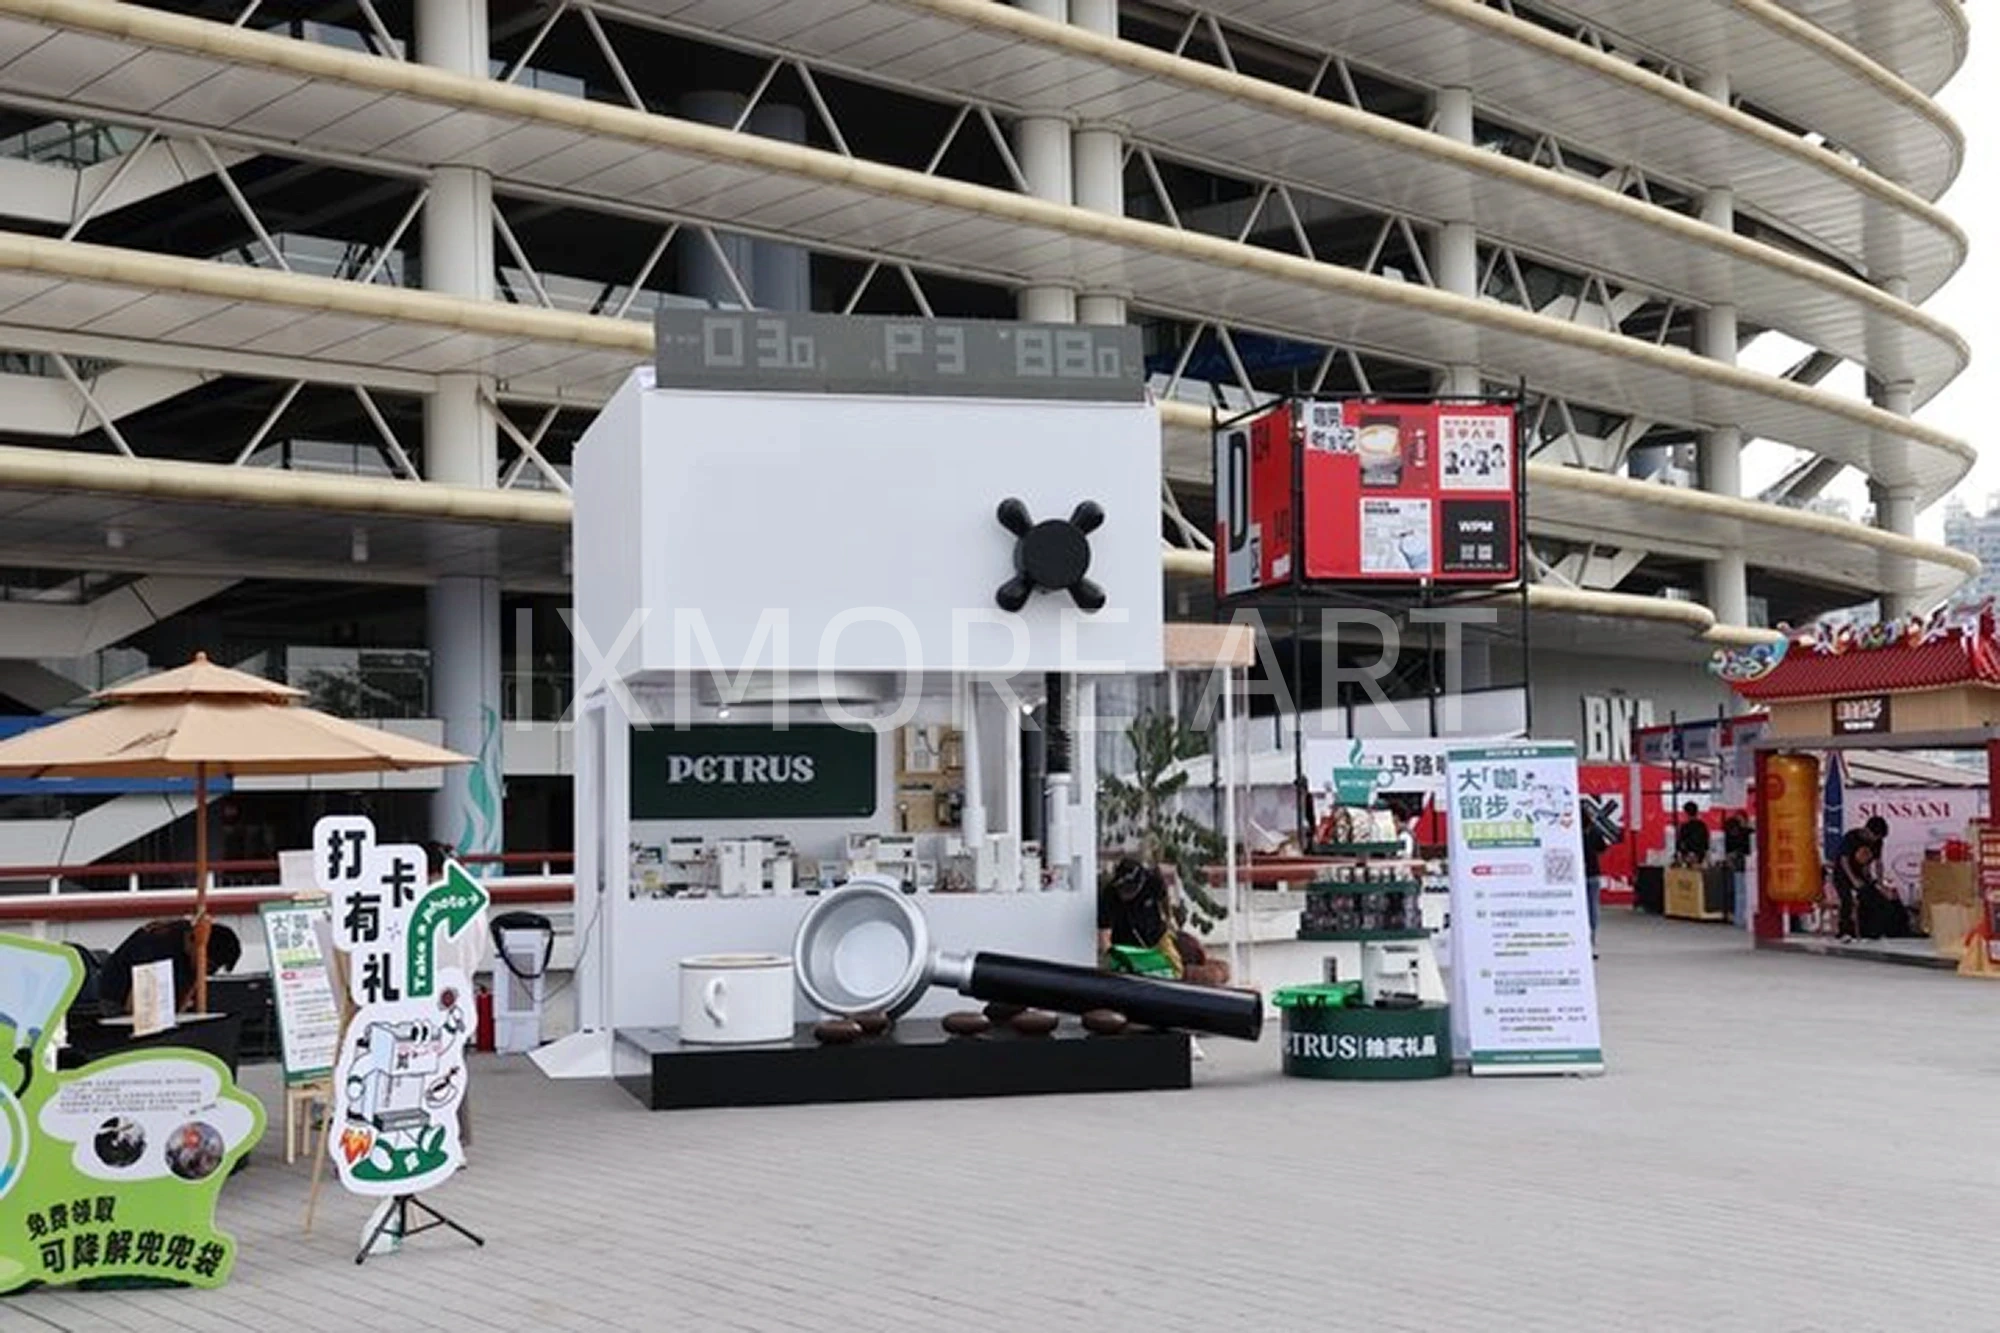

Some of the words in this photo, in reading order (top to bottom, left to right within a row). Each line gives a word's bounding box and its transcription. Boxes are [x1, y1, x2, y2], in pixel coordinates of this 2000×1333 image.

[667, 754, 815, 783] PETRUS
[1366, 1034, 1437, 1059] 抽奖礼品
[26, 1195, 117, 1241] 免费领取
[39, 1229, 225, 1278] 可降解兜兜袋
